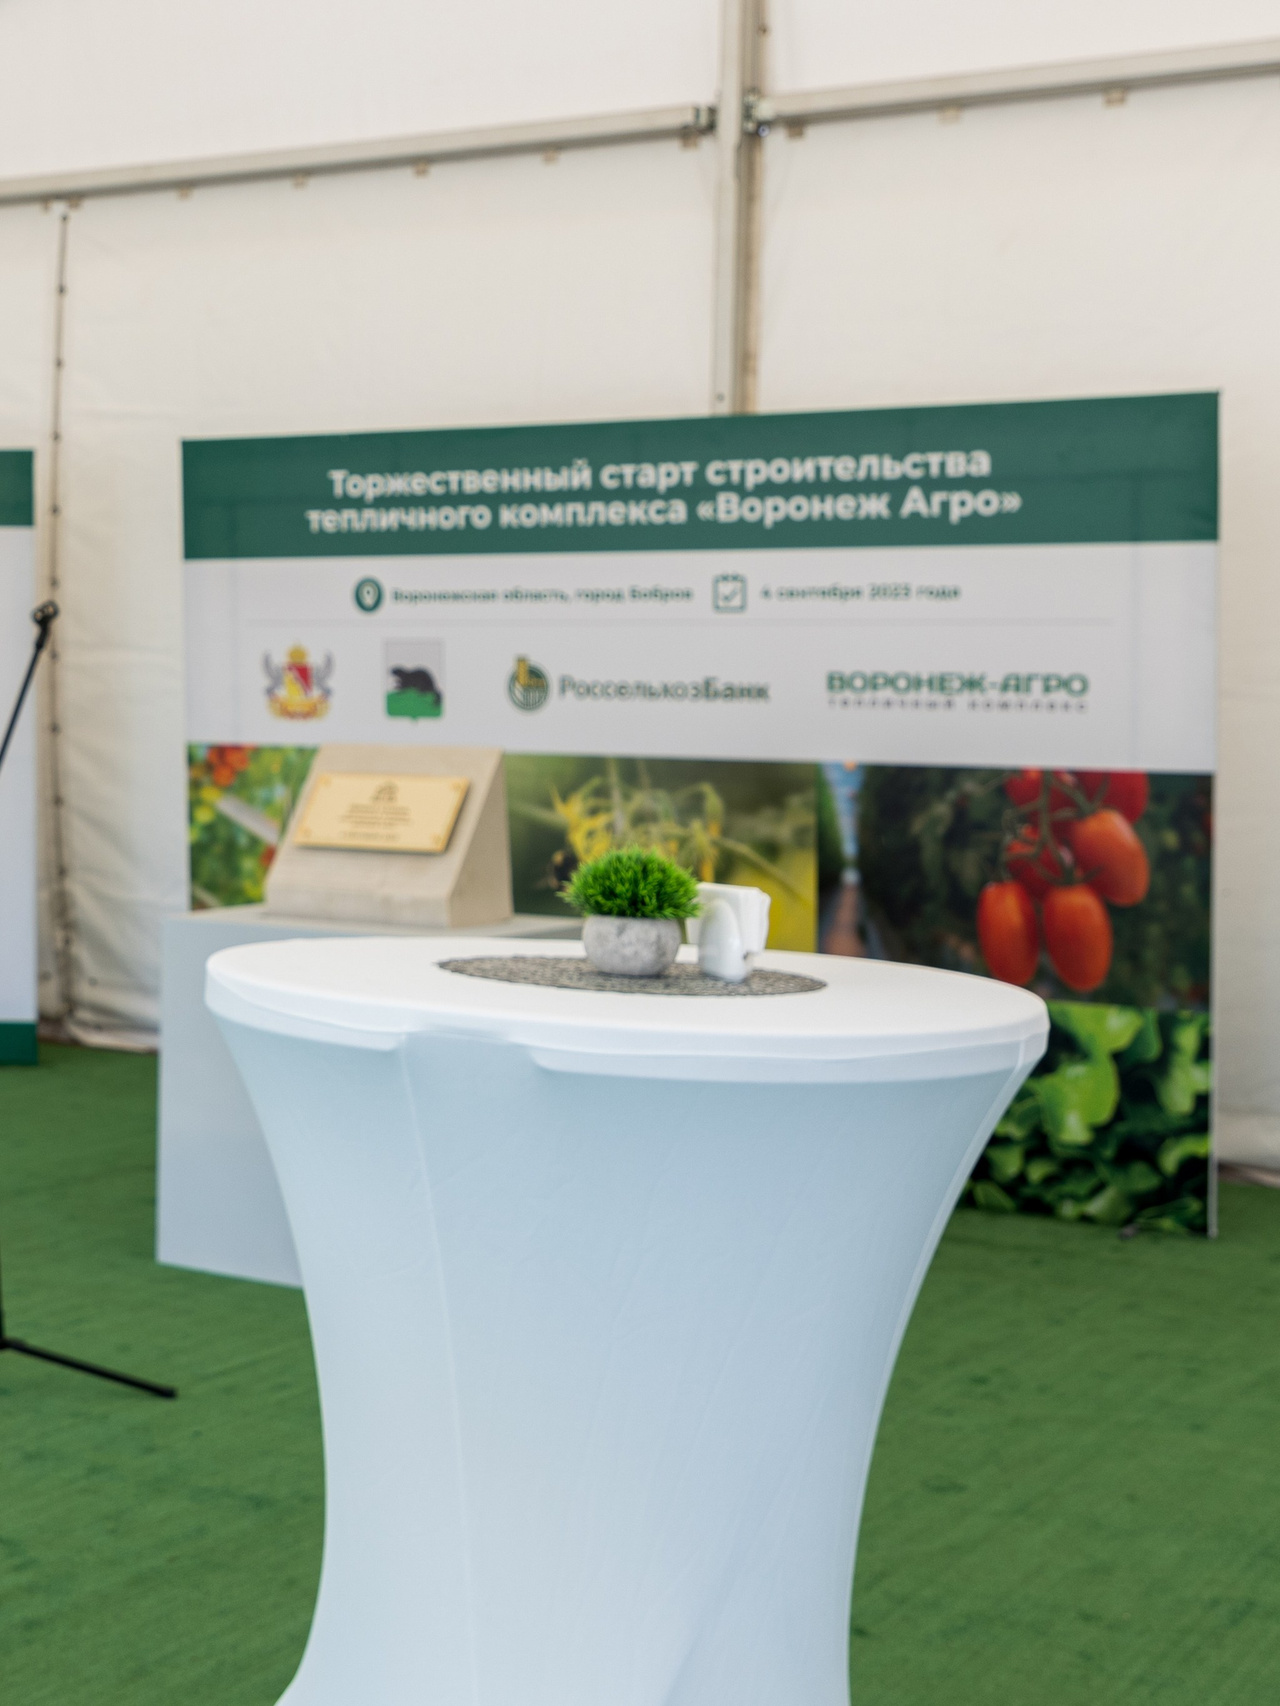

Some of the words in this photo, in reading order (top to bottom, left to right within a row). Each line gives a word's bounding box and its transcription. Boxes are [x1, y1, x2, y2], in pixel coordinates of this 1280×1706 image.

[328, 460, 592, 500] Торжественный
[600, 461, 698, 494] старт
[705, 451, 993, 490] строительства
[306, 504, 493, 534] тепличного
[499, 498, 688, 532] комплекса
[696, 492, 892, 528] «Воронеж
[900, 486, 1023, 525] Агро»
[390, 587, 499, 606] Воронежская
[574, 588, 624, 606] город
[627, 584, 694, 605] Бобров
[775, 583, 864, 603] сентября
[915, 585, 963, 602] года
[557, 673, 771, 704] РоссельхозБанк
[825, 670, 1091, 698] ВОРОНЕЖ-АГРО
